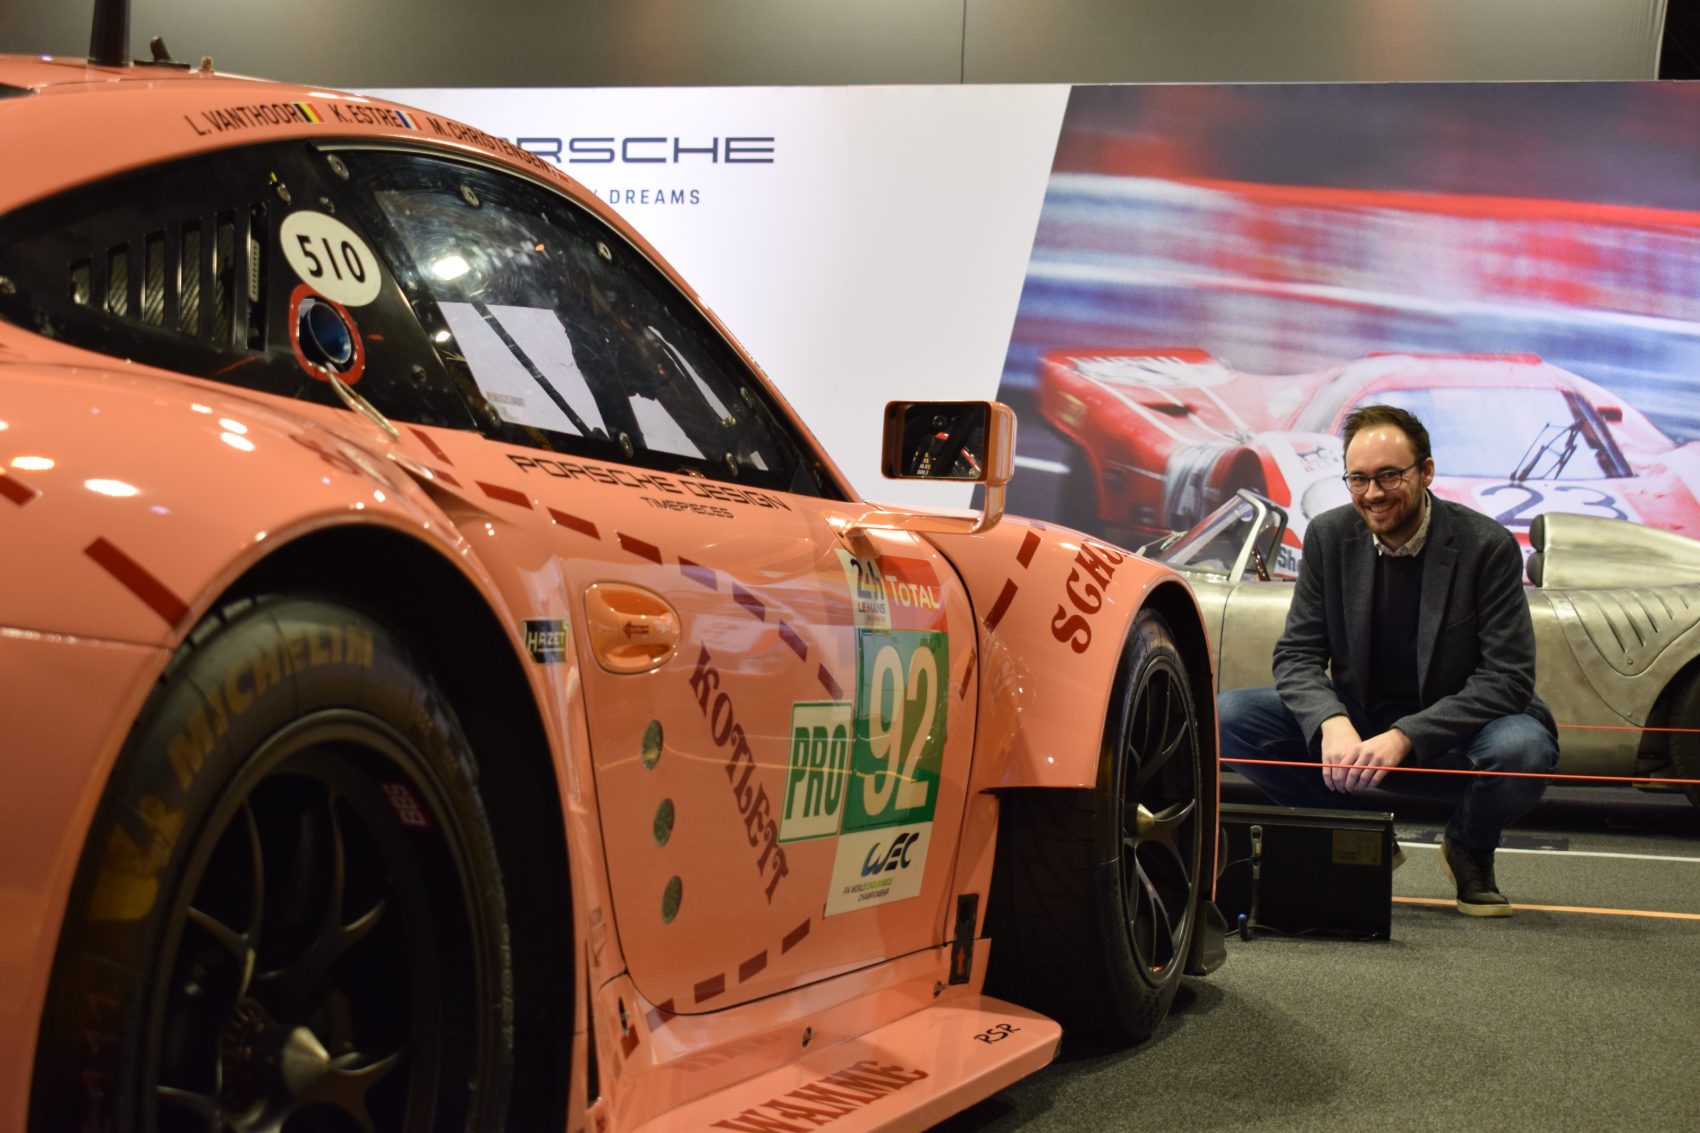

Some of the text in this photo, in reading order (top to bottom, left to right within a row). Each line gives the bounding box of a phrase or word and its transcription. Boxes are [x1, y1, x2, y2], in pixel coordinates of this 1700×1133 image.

[500, 137, 775, 164] RSCHE
[610, 189, 700, 205] DREAMS
[296, 233, 366, 284] 510
[505, 454, 793, 512] PORSCHE DESIGN
[640, 496, 734, 519] TIMEPIECES
[1480, 484, 1628, 526] 23
[1278, 546, 1300, 573] Sh
[885, 575, 940, 609] TOTAL
[527, 631, 567, 653] HAZET
[169, 624, 374, 791] MICHELIN
[863, 645, 938, 816] 92
[785, 724, 848, 820] PRO
[861, 832, 920, 876] WEC
[973, 1023, 1021, 1045] RSR
